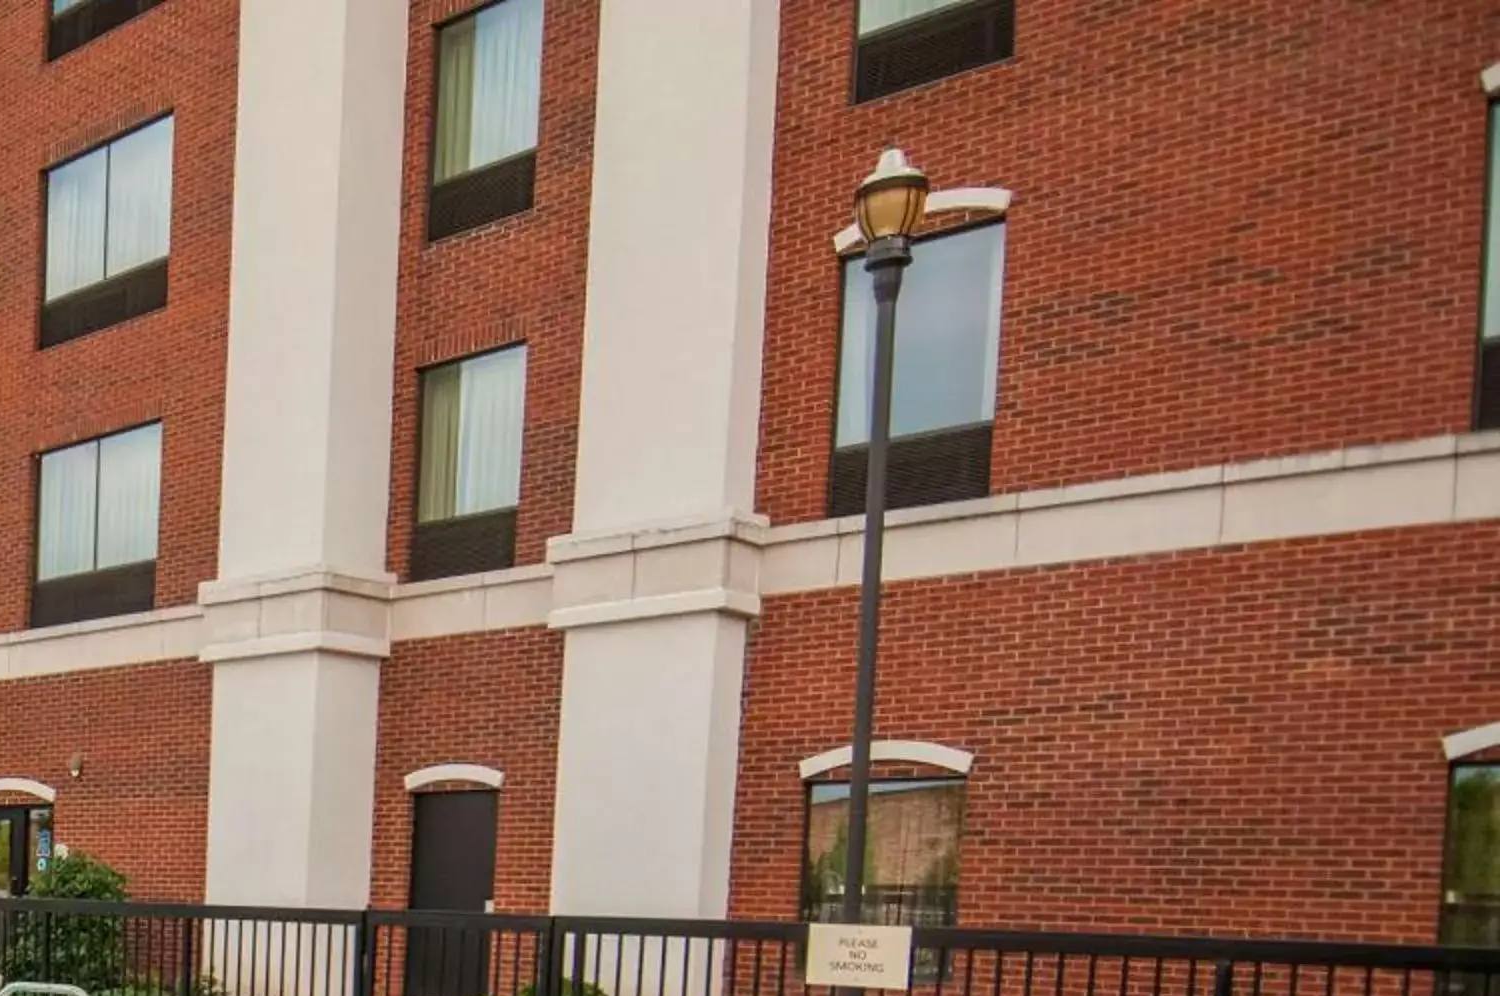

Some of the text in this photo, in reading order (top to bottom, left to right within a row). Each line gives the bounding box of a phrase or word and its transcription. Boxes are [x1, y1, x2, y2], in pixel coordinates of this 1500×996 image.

[838, 938, 878, 949] PLEASE
[848, 950, 867, 960] NO
[829, 961, 884, 973] SMOKING
